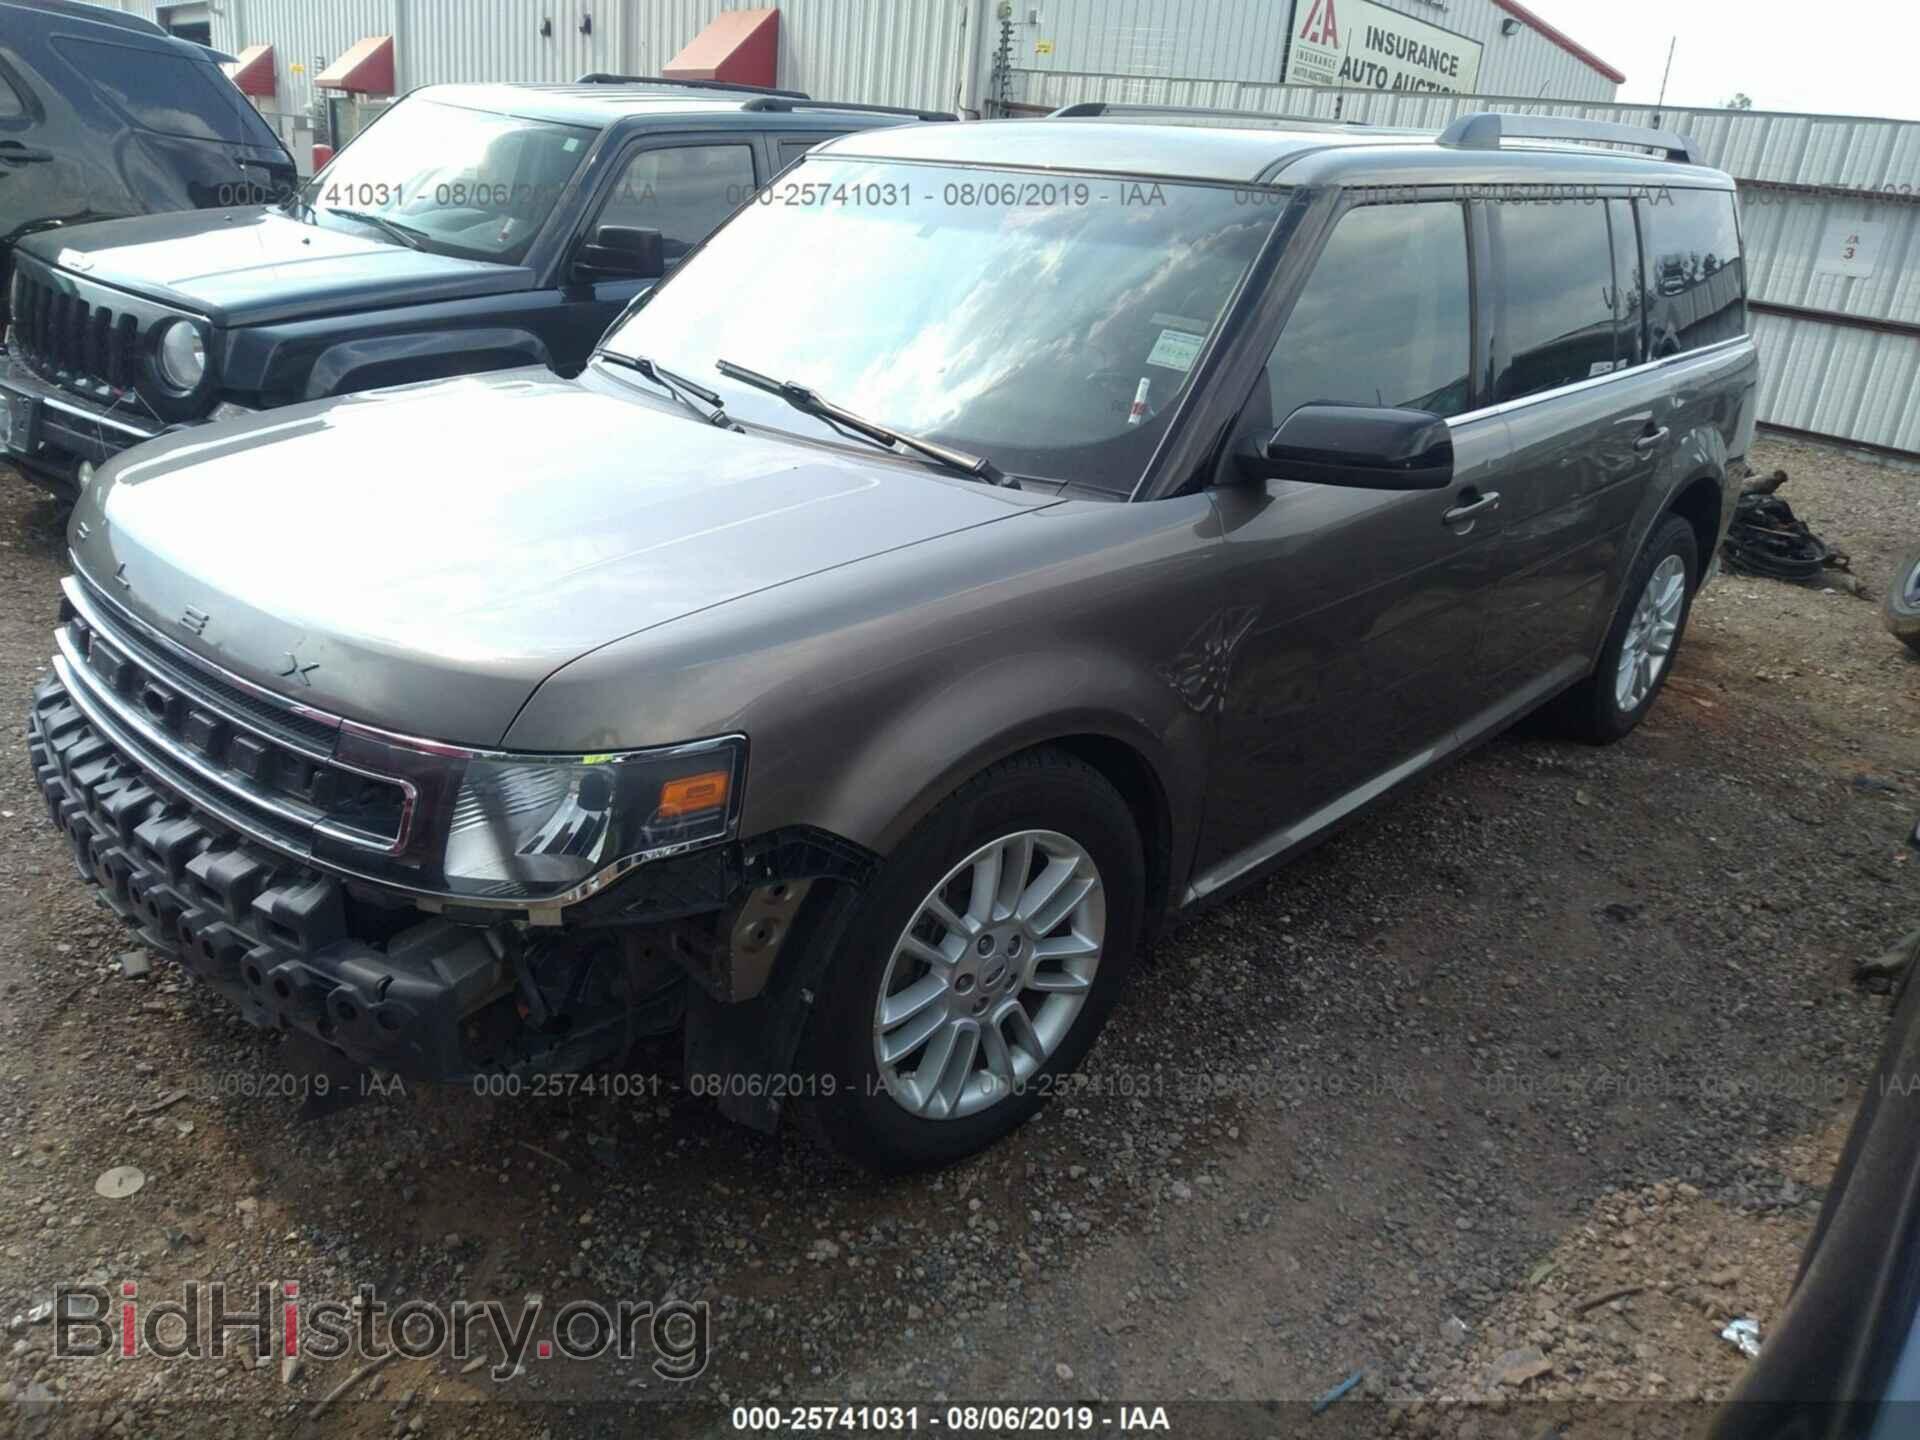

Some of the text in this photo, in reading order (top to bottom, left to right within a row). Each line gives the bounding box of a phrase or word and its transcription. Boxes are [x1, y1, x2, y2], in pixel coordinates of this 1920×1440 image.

[1365, 25, 1459, 77] INSURANCE
[1338, 56, 1388, 89] AUTO
[1843, 247, 1855, 259] 3
